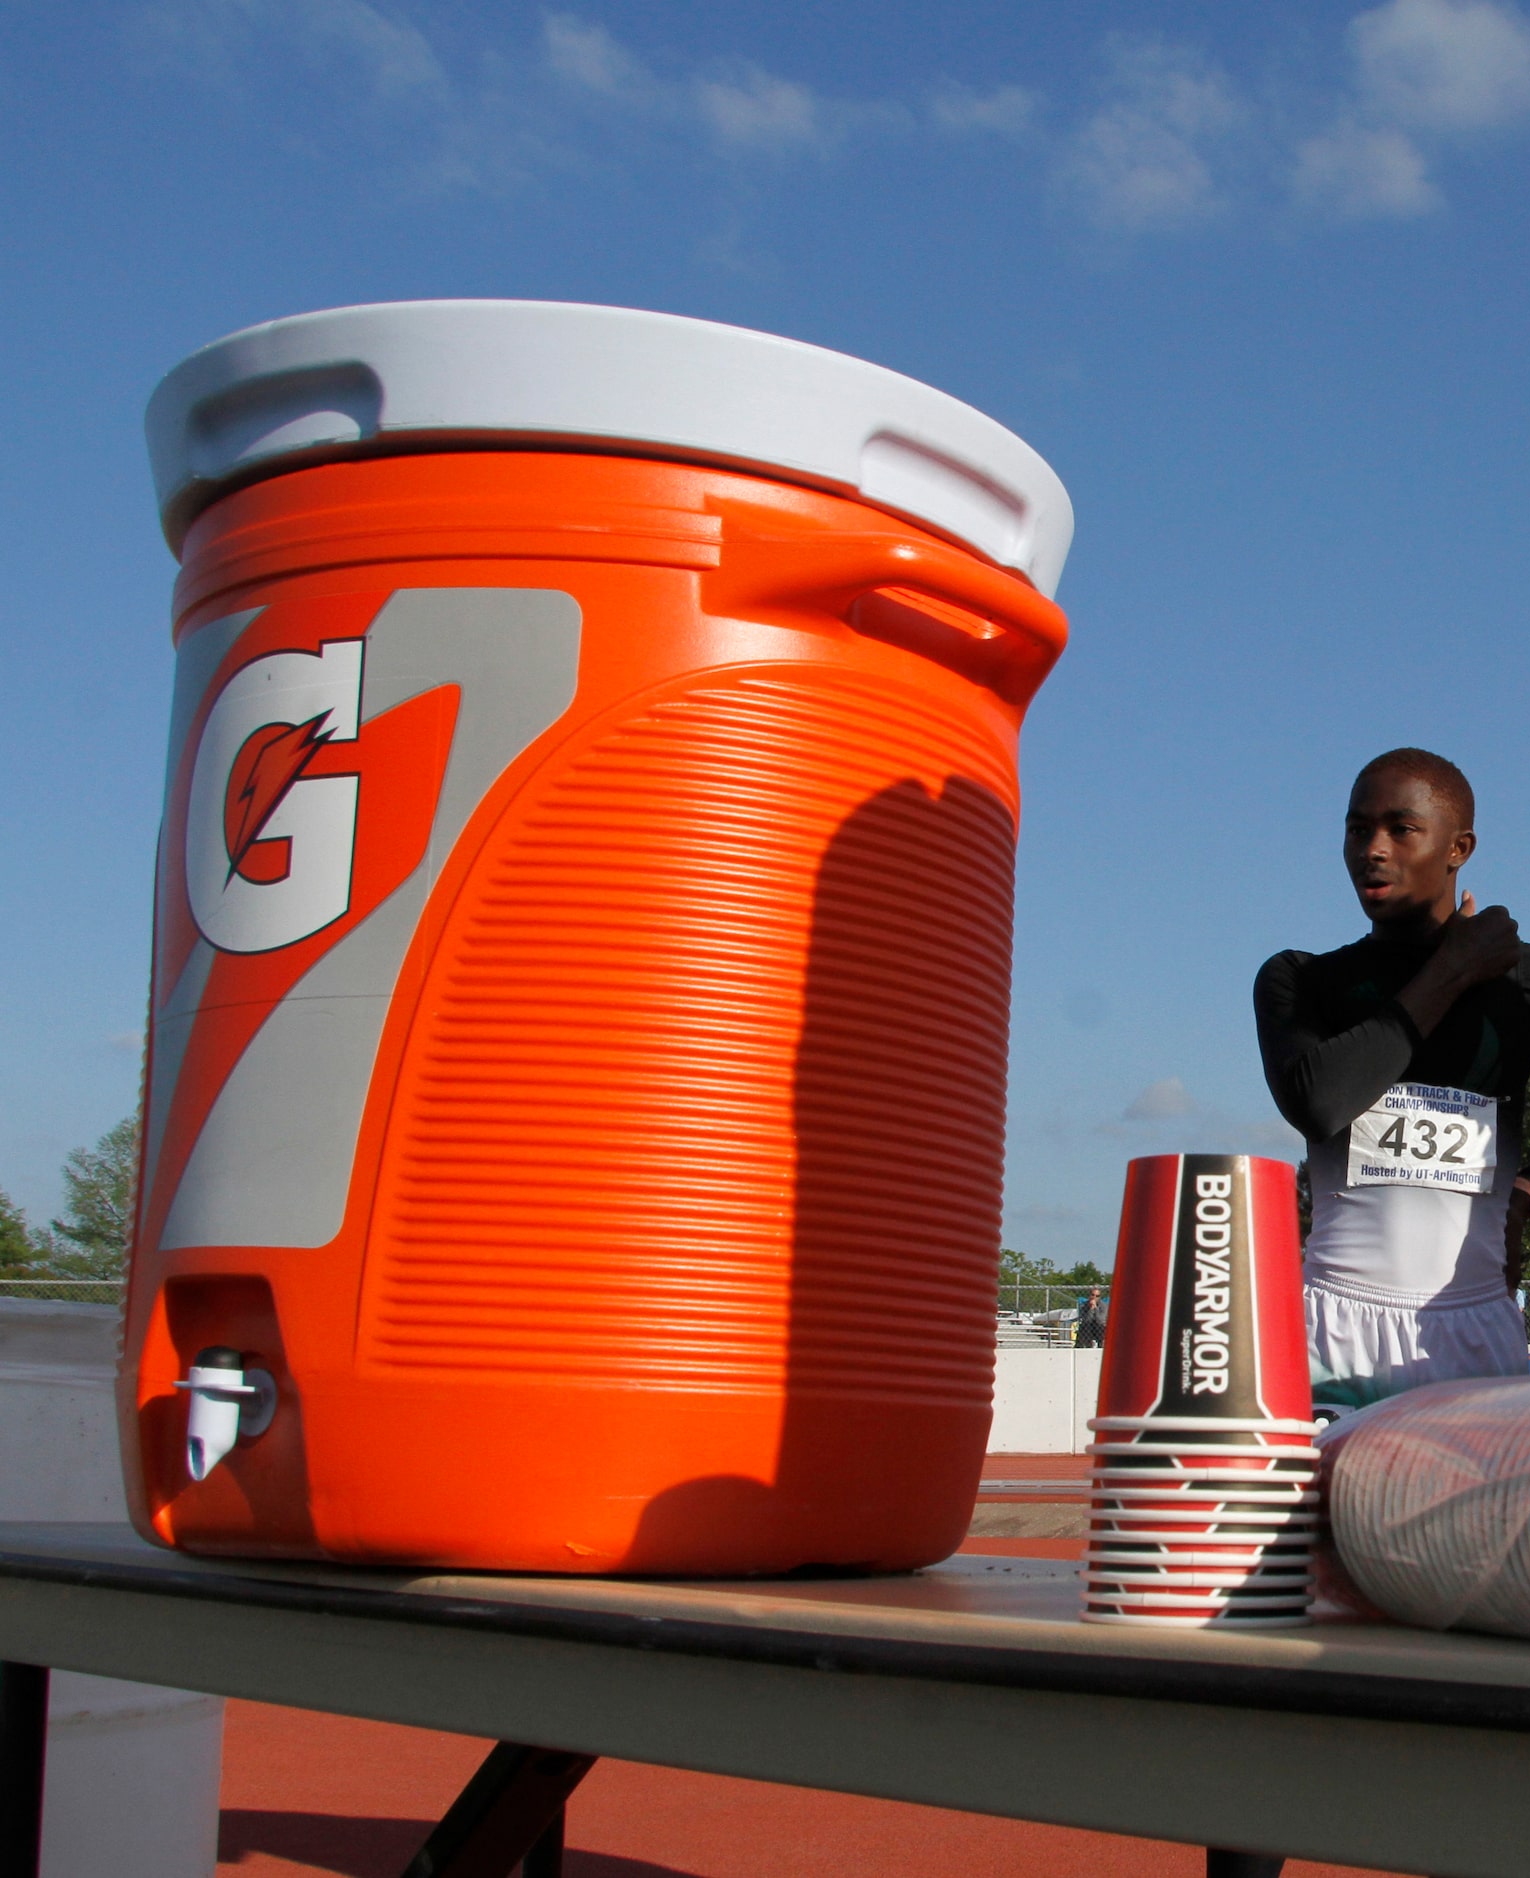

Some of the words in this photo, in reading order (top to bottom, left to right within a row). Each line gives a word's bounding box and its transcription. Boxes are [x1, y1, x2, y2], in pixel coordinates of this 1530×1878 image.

[184, 635, 366, 955] G
[1385, 1096, 1469, 1117] CHAMPIONSHIPS
[1416, 1085, 1450, 1100] TRACK
[1453, 1091, 1461, 1103] &
[1464, 1092, 1489, 1108] FIELD
[1378, 1117, 1469, 1164] 432
[1361, 1164, 1396, 1178] Hosted
[1399, 1168, 1413, 1179] by
[1416, 1169, 1481, 1184] UT-Arlington
[1193, 1173, 1232, 1396] BODYARMOR
